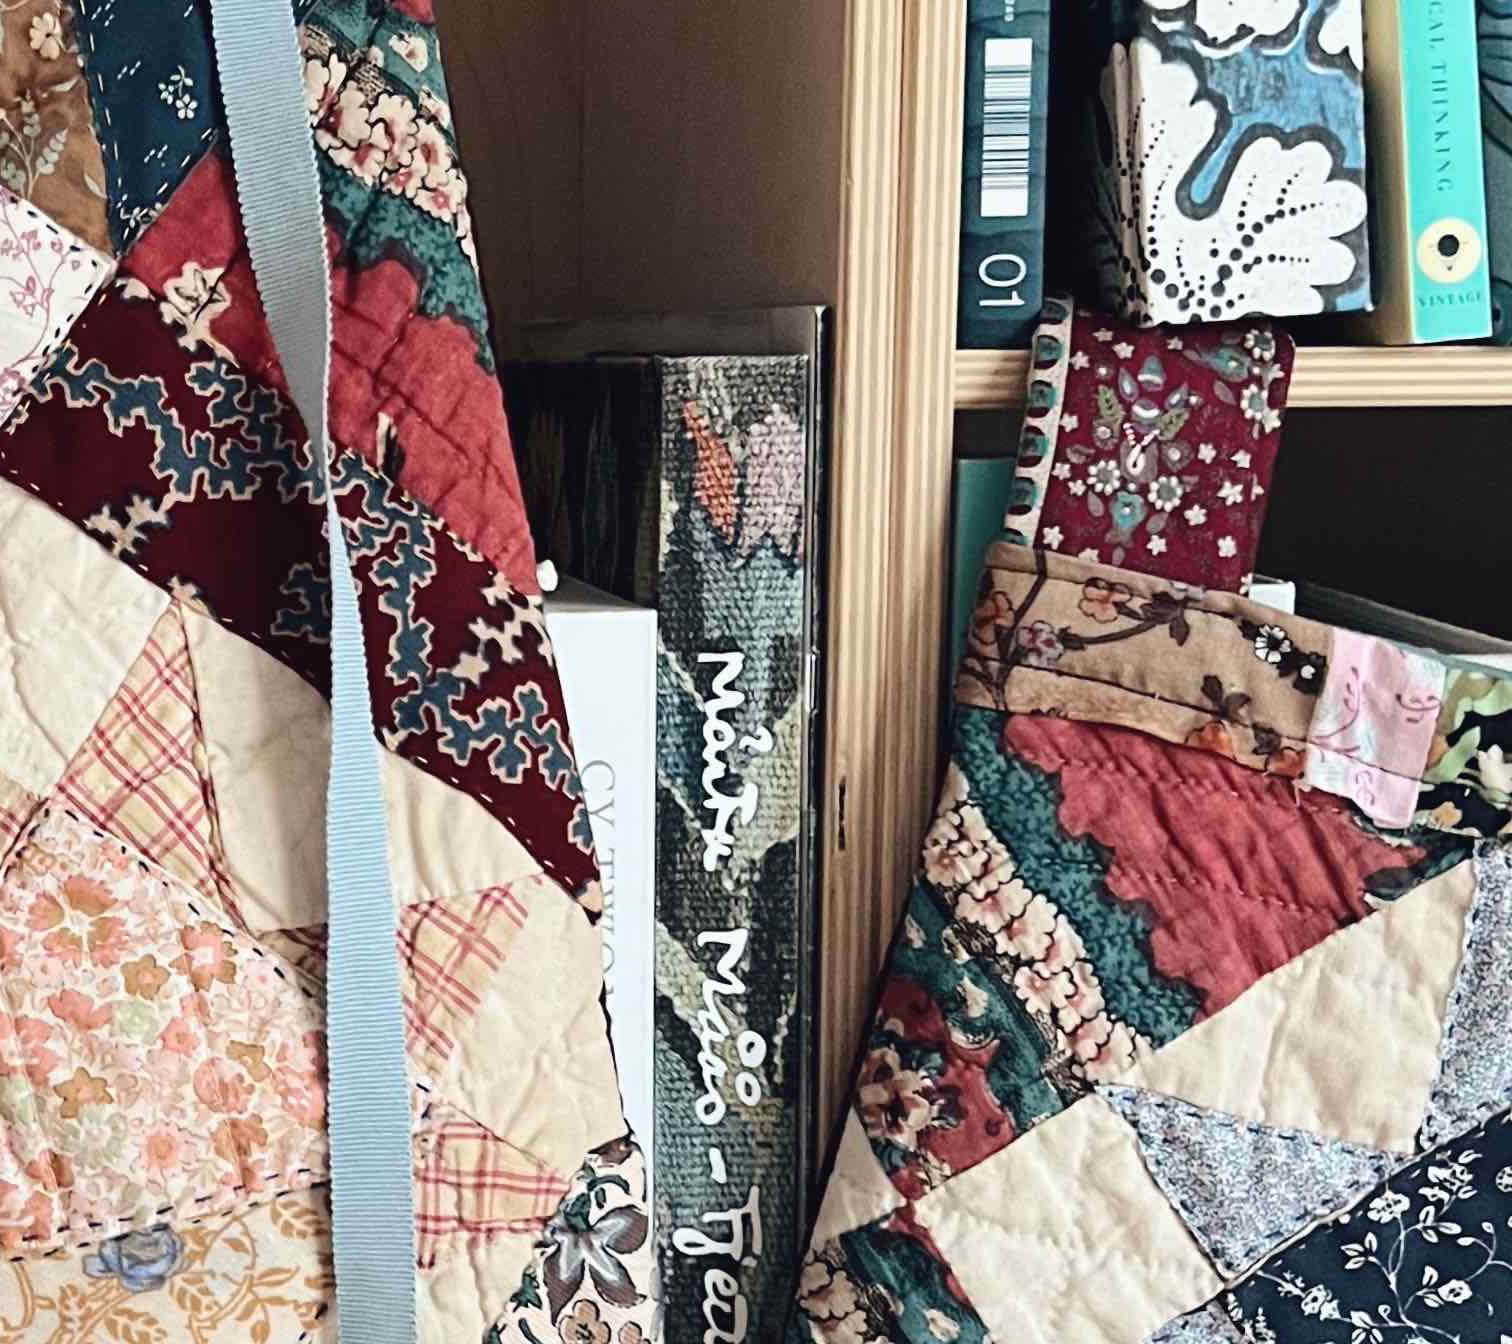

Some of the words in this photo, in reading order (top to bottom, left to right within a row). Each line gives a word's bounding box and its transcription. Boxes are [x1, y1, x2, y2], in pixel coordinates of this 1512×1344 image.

[1426, 59, 1455, 193] THINKING
[977, 252, 1028, 309] 01
[1417, 290, 1483, 308] VINTAGE
